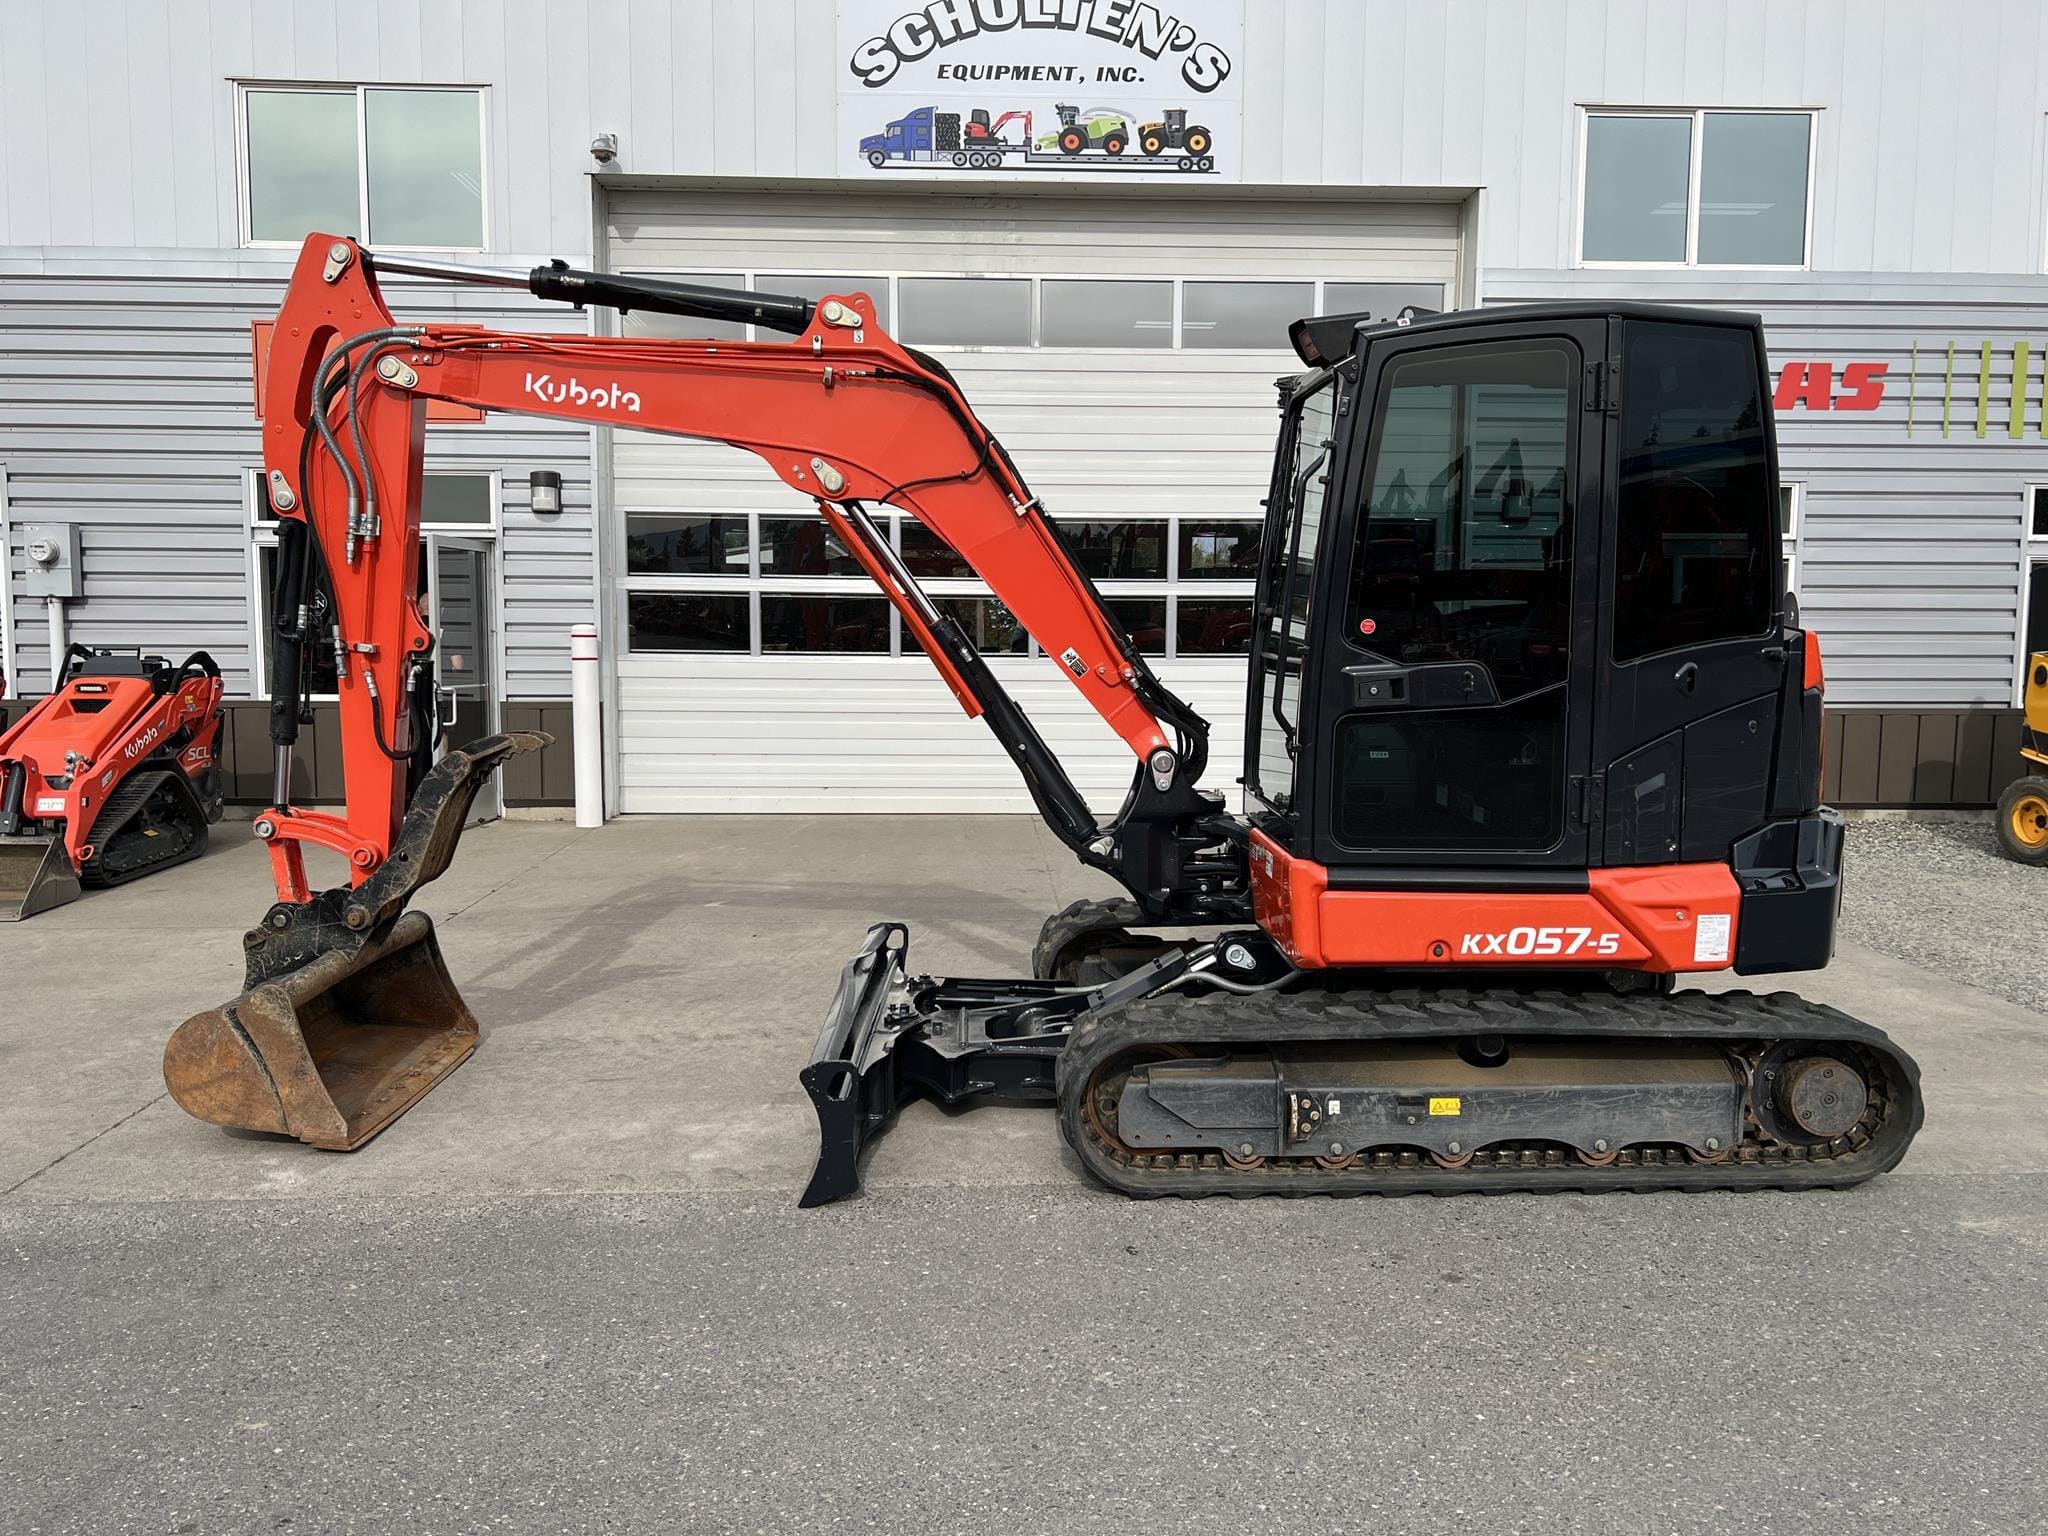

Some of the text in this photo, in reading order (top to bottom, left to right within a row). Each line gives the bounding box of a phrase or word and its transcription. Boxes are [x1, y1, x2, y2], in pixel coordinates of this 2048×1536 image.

[937, 64, 1145, 84] EQUIPMENT, INC.
[525, 372, 641, 412] Kubota
[124, 727, 158, 758] Kubota
[187, 746, 210, 761] SCL
[1460, 927, 1620, 955] KX057-5
